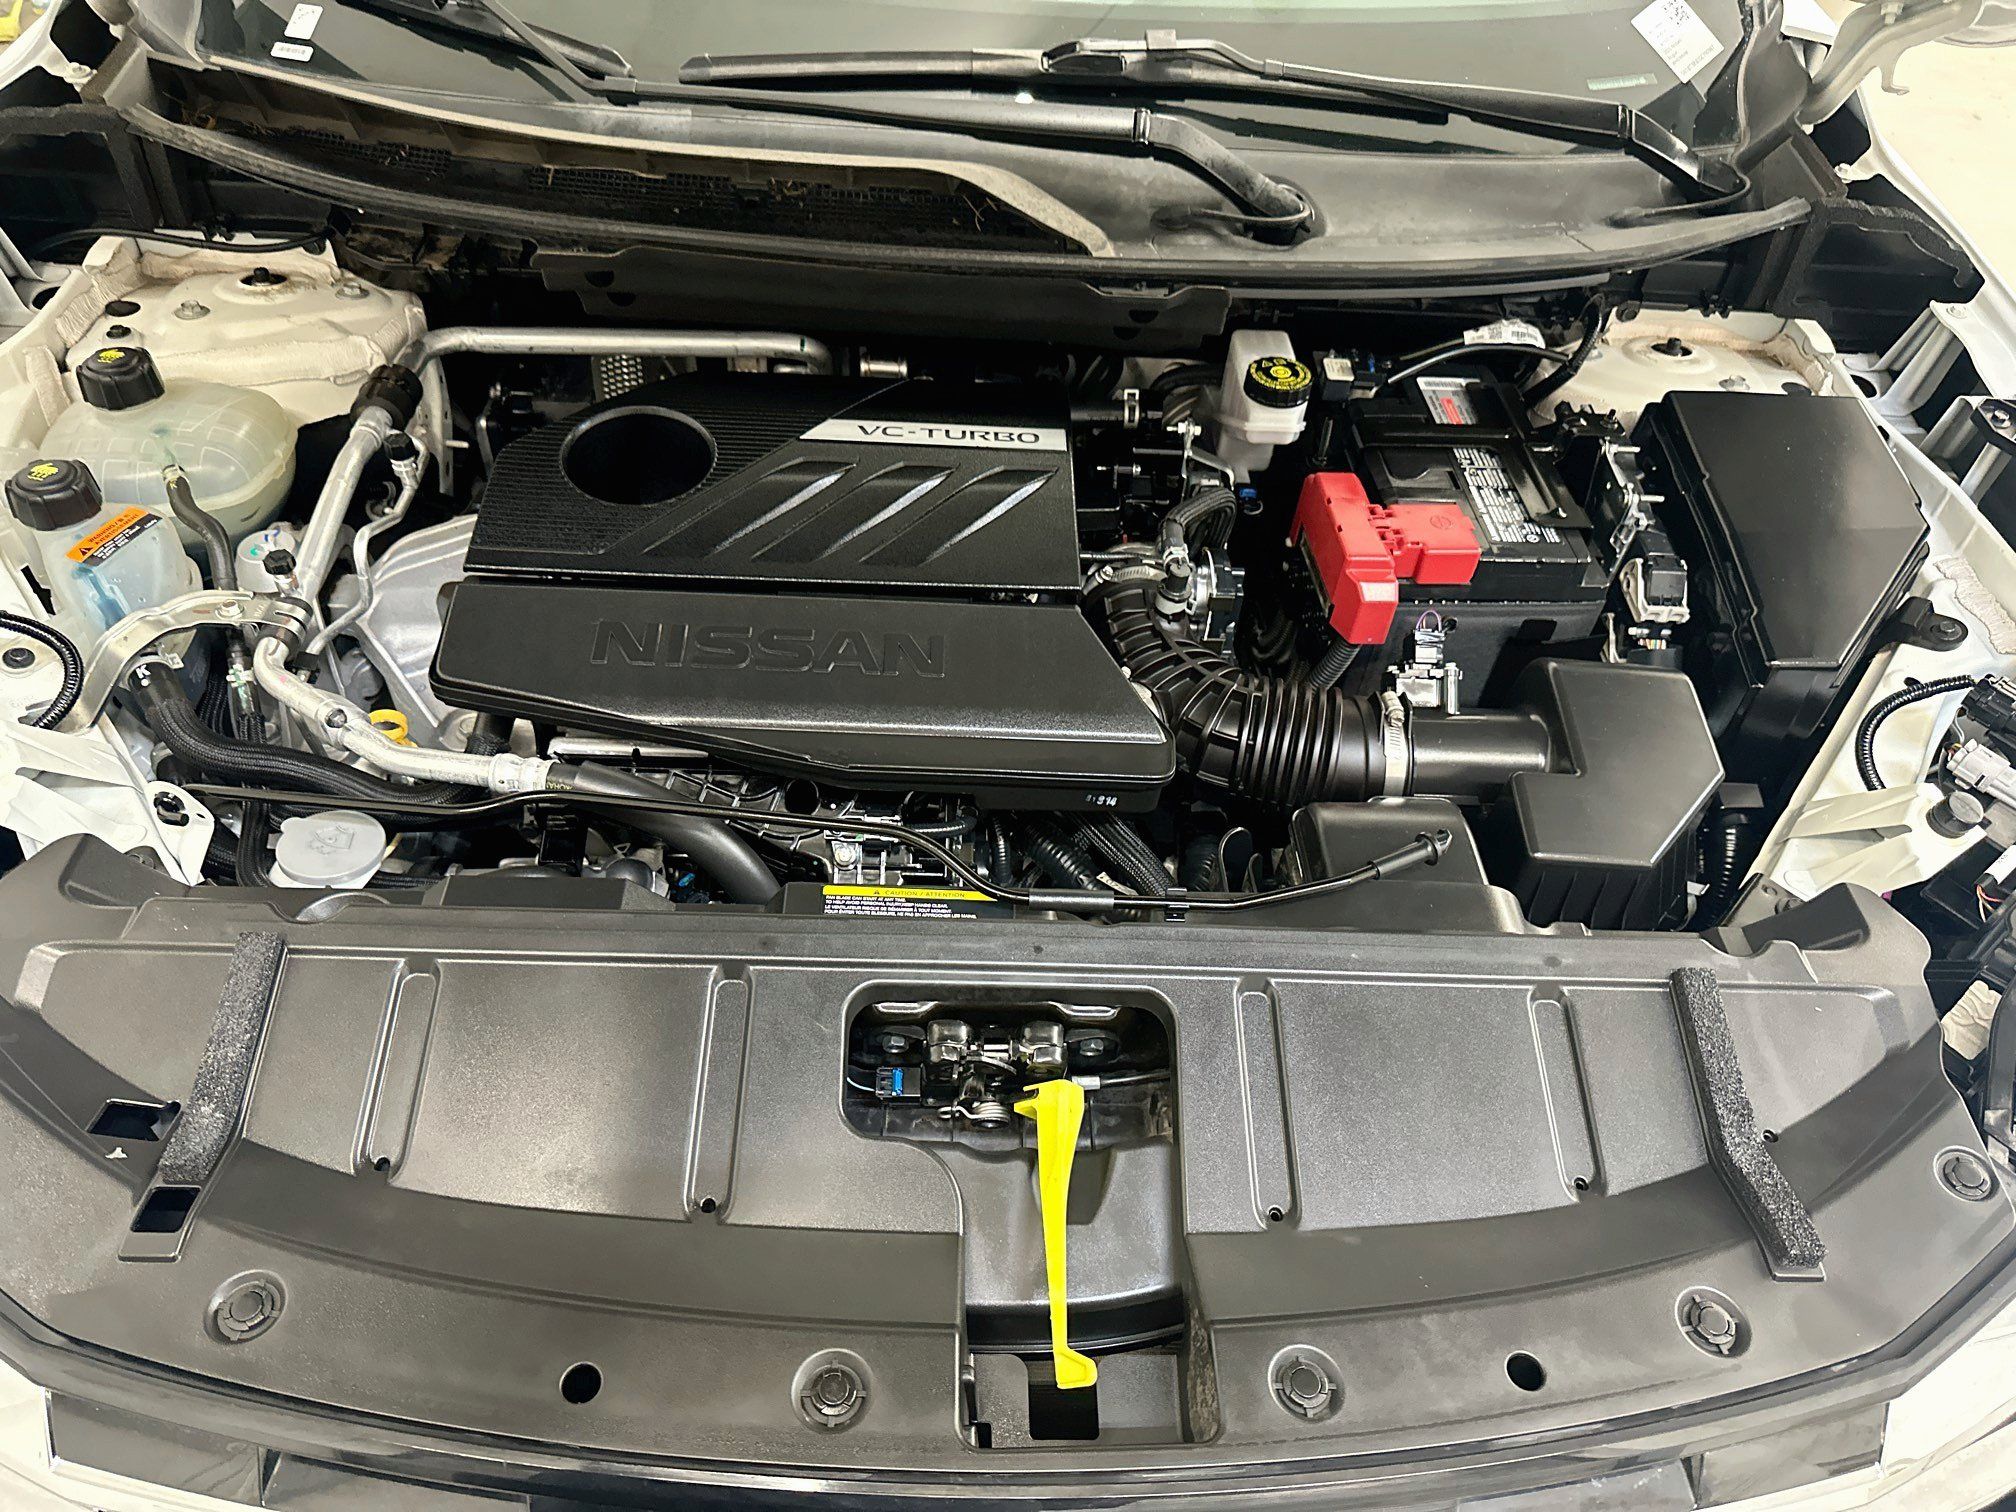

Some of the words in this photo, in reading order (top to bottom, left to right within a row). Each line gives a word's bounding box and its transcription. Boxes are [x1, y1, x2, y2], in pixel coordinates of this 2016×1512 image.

[857, 424, 1040, 444] VC-TURBO
[590, 618, 946, 678] NISSAN
[135, 664, 152, 679] K
